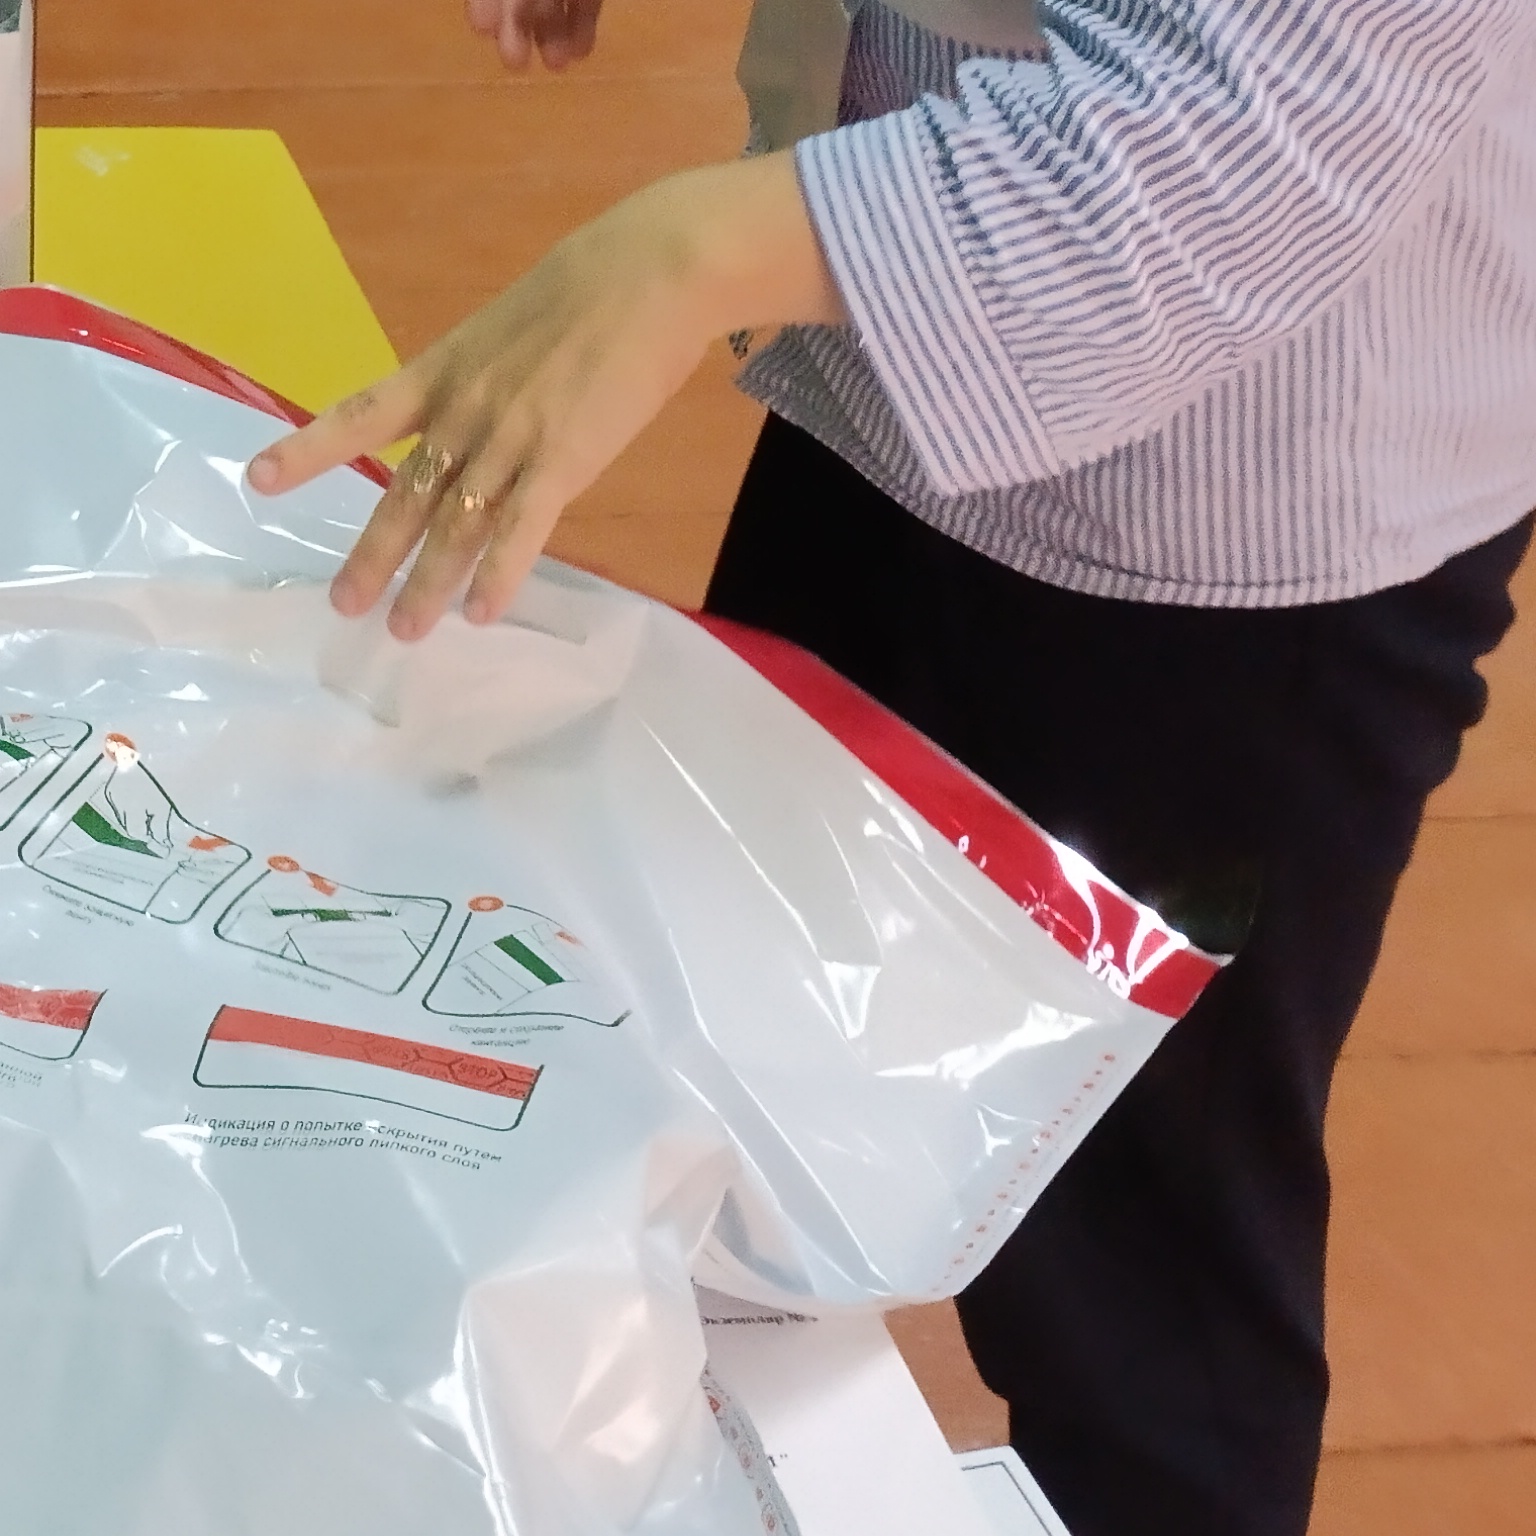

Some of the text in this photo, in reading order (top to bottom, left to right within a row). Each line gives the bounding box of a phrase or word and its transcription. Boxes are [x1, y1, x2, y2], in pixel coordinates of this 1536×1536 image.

[184, 1112, 502, 1163] Идикация о попытке скрытия путем
[264, 1134, 365, 1149] сигнального
[368, 1138, 436, 1159] липкого
[442, 1152, 482, 1170] слоя
